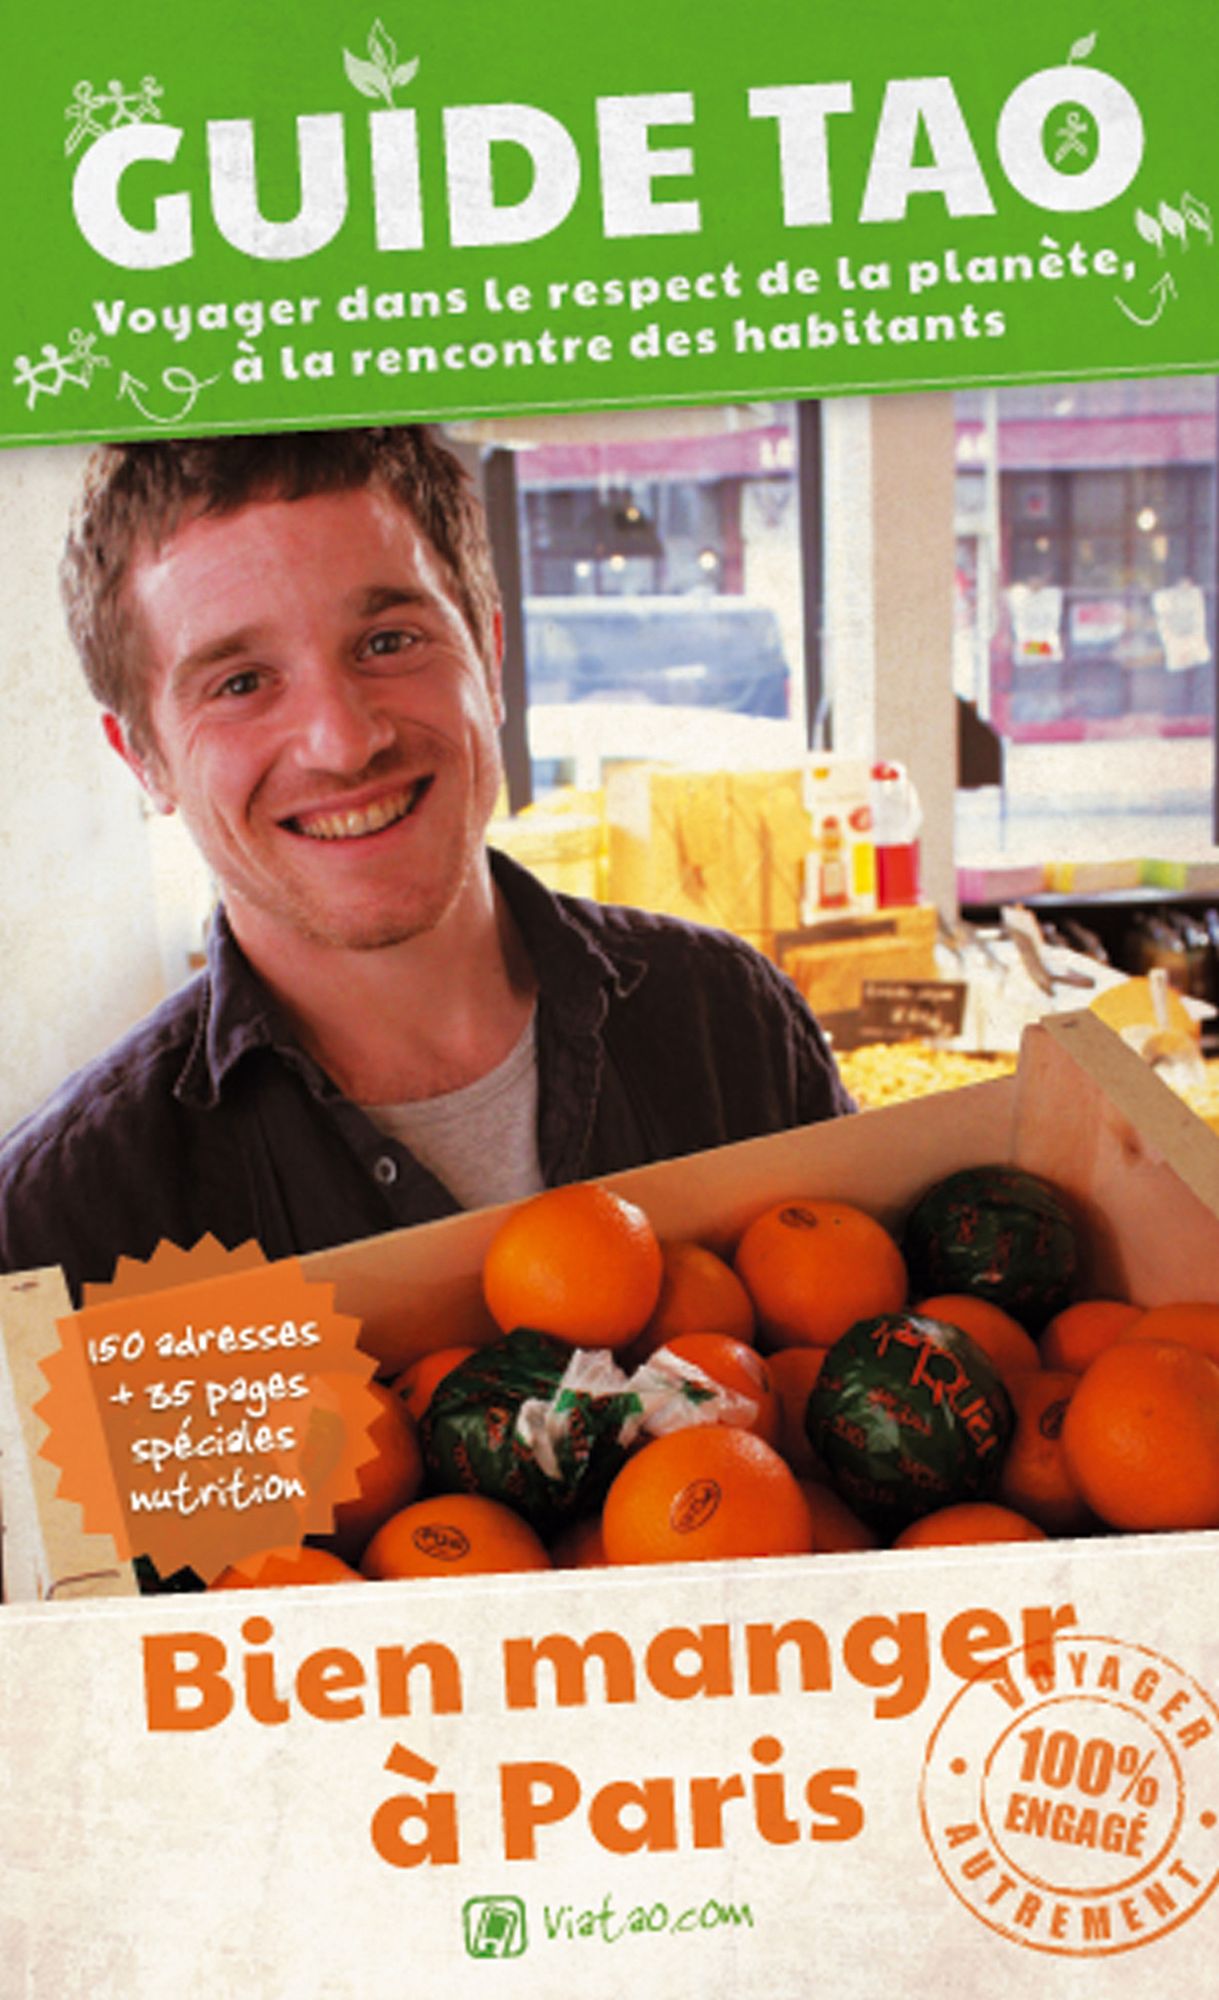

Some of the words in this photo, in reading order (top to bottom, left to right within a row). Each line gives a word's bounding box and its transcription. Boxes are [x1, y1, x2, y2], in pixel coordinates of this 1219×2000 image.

[71, 92, 702, 269] GUIDE
[747, 65, 1145, 227] TAO
[94, 299, 320, 342] Voyager
[337, 286, 468, 322] dans
[484, 278, 532, 312] le
[548, 263, 742, 311] respect
[757, 260, 820, 297] de
[837, 256, 891, 291] la
[908, 235, 1136, 294] planète,
[232, 339, 264, 384] à
[281, 346, 335, 380] la
[352, 329, 613, 376] rencontre
[629, 323, 717, 359] des
[734, 304, 1006, 353] habitants
[88, 1331, 145, 1365] 150
[155, 1320, 321, 1358] adresses
[109, 1382, 134, 1408] +
[145, 1379, 196, 1411] 35
[205, 1371, 310, 1418] pages
[131, 1415, 297, 1472] spéciales
[129, 1467, 306, 1515] nutrition
[141, 1615, 463, 1733] Bien
[502, 1603, 1077, 1720] manger
[992, 1651, 1213, 1749] VOYAGER
[370, 1742, 460, 1869] à
[499, 1735, 865, 1861] Paris
[1018, 1726, 1159, 1808] 100%
[1003, 1792, 1149, 1858] ENGAGÉ
[944, 1822, 1202, 1941] AUTREMENT
